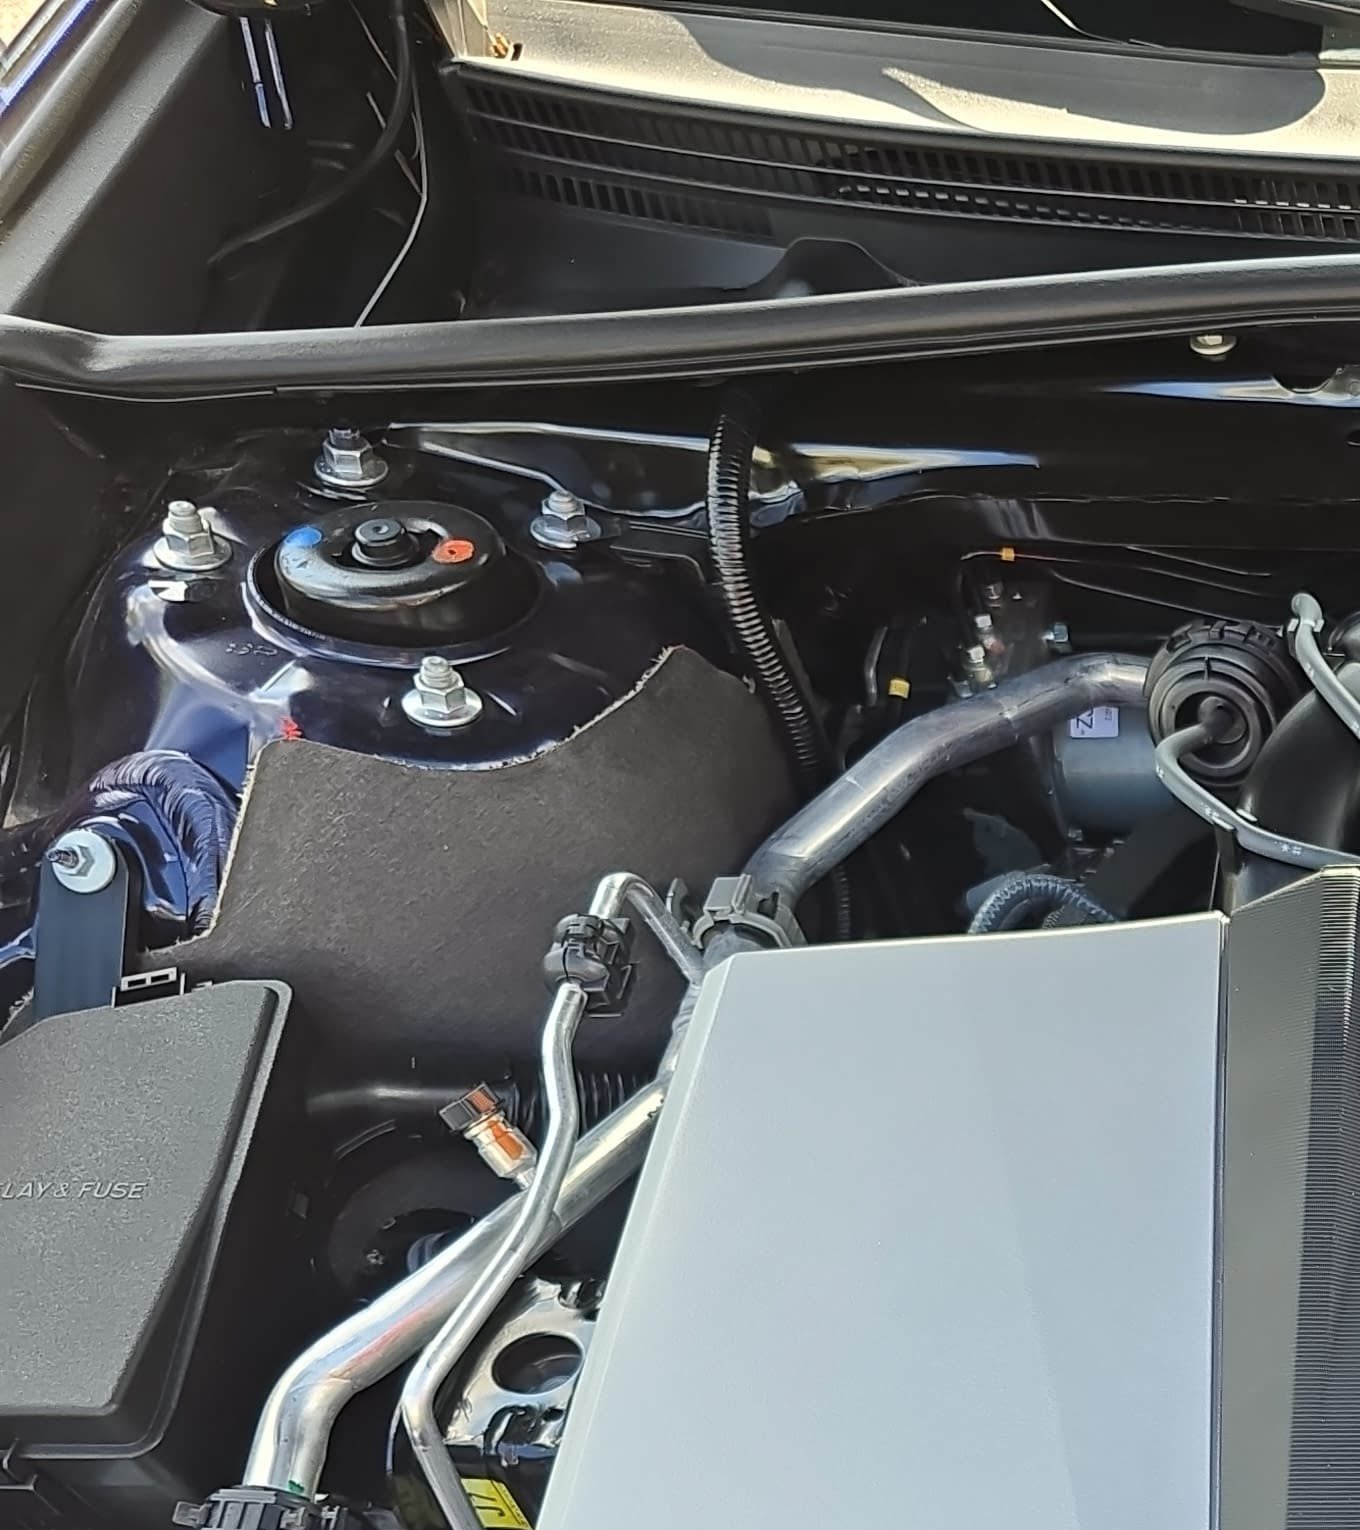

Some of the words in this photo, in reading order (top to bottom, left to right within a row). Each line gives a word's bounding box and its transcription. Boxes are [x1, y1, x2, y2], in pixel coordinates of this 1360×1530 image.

[0, 1182, 51, 1200] LAY
[53, 1182, 70, 1199] &
[78, 1182, 148, 1200] FUSE
